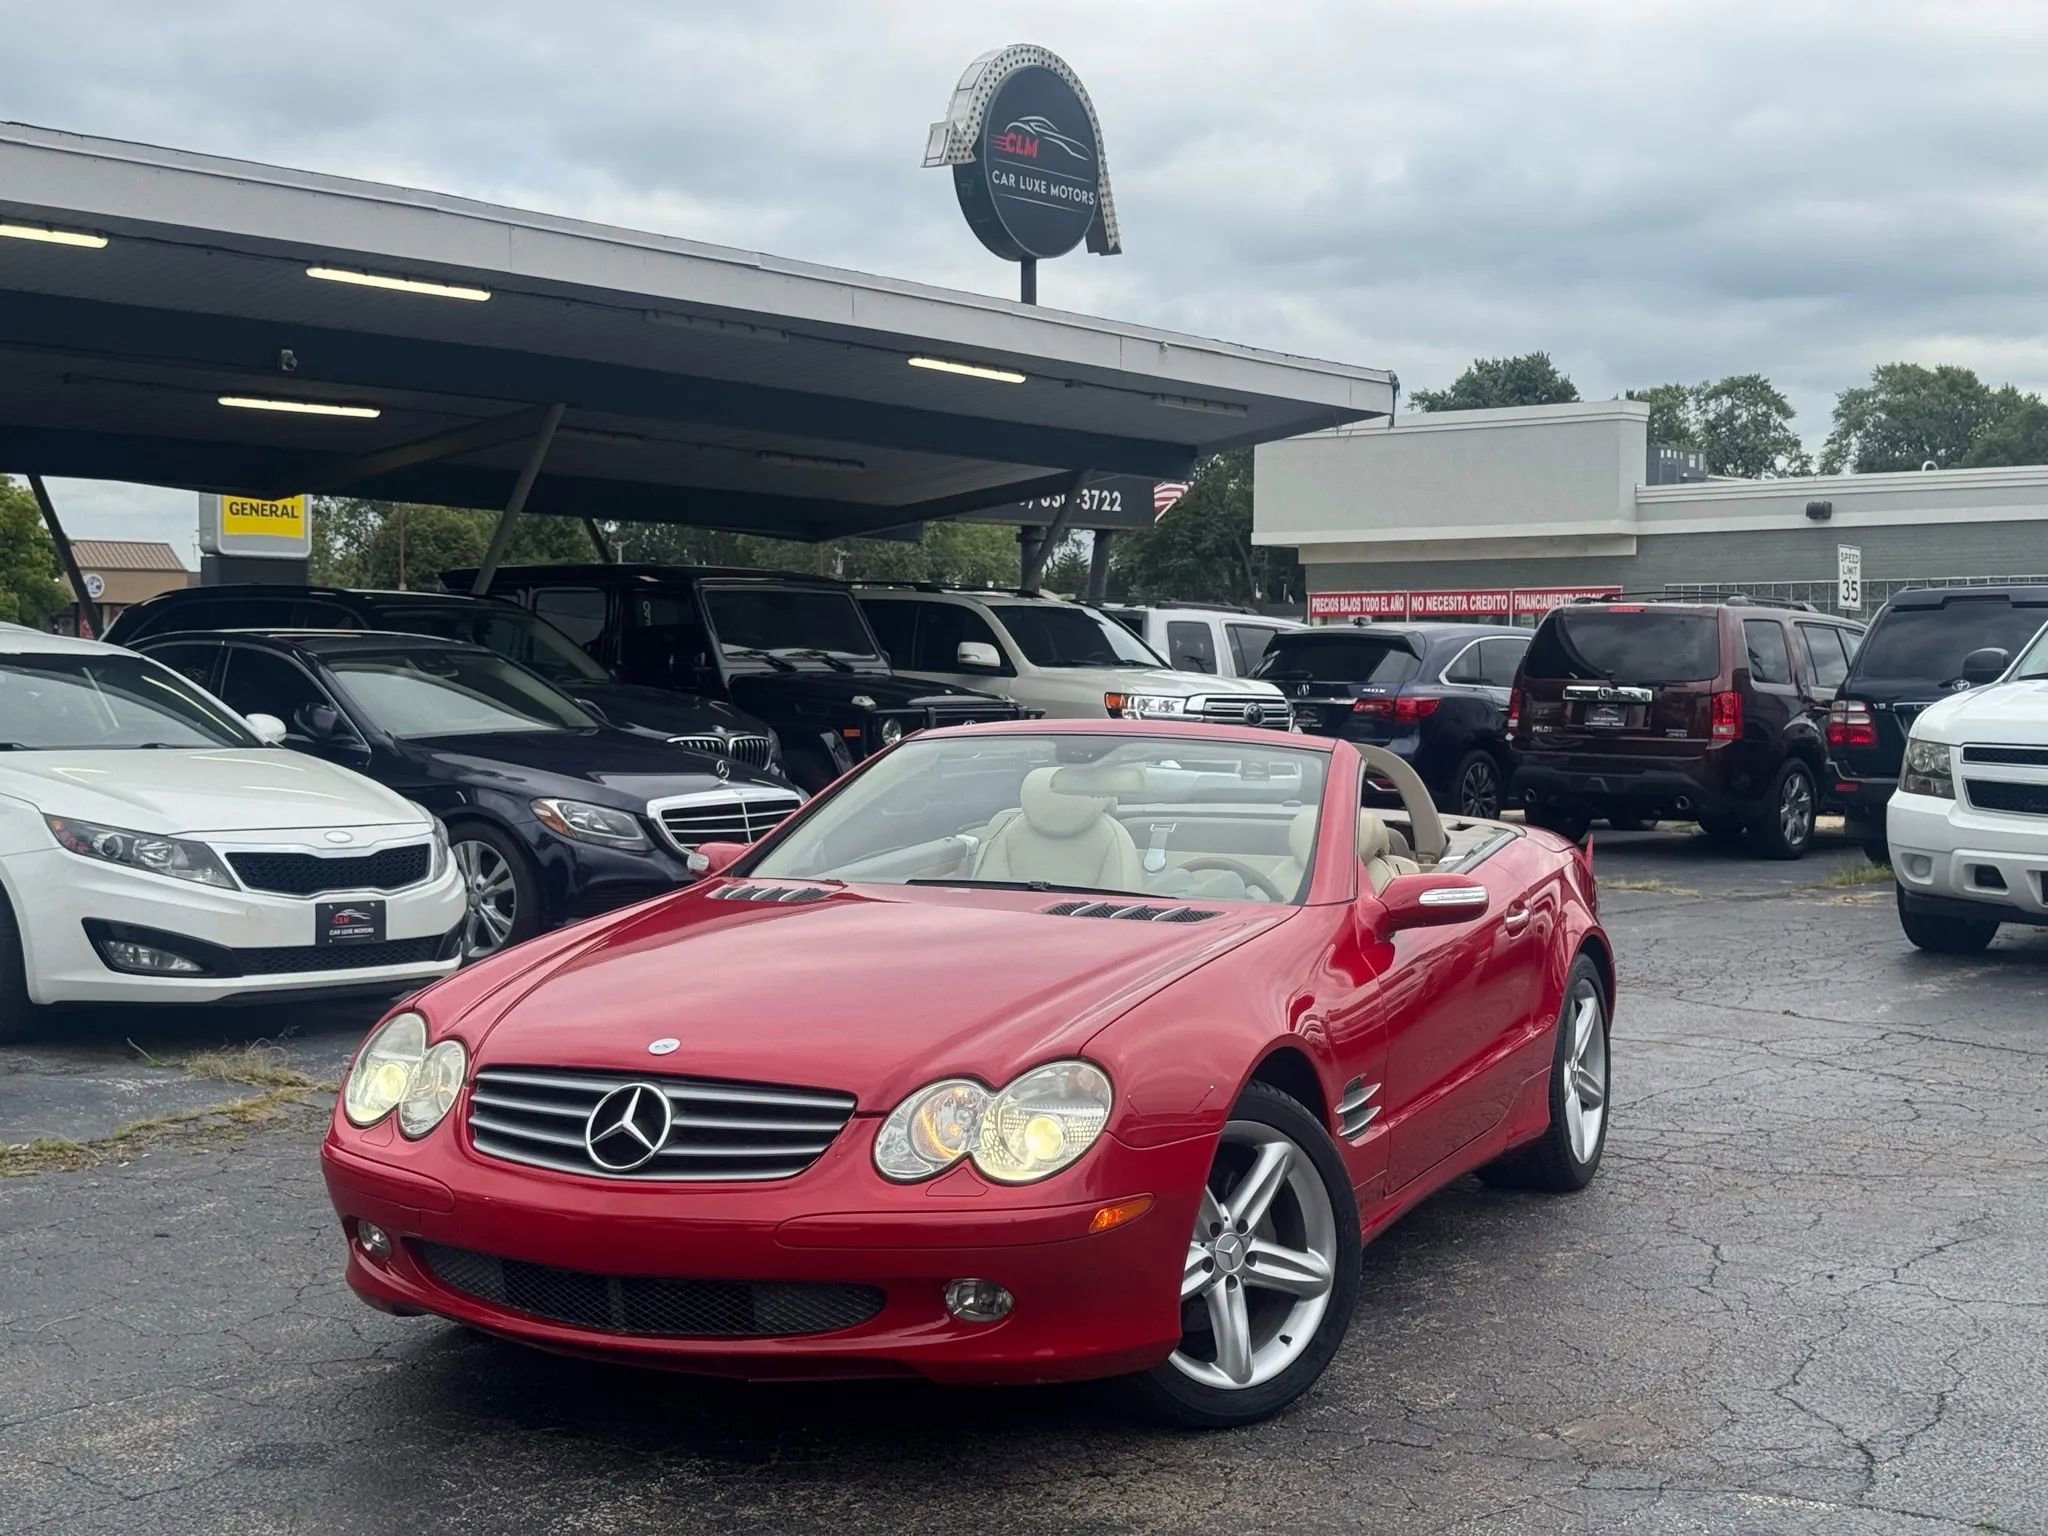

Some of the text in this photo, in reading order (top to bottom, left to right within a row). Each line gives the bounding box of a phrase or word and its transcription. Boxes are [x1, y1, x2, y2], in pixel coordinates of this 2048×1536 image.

[1005, 132, 1040, 159] CLM
[992, 169, 1095, 206] CAR LUXE MOTORS
[229, 501, 299, 519] GENERAL
[1841, 552, 1859, 565] SPEED
[1842, 564, 1858, 576] LIMIT
[1842, 579, 1859, 602] 35
[1312, 594, 1405, 613] PRECIOS BAJOS TODO EL AÑO
[1411, 594, 1508, 612] NO NECESITA CREDITO
